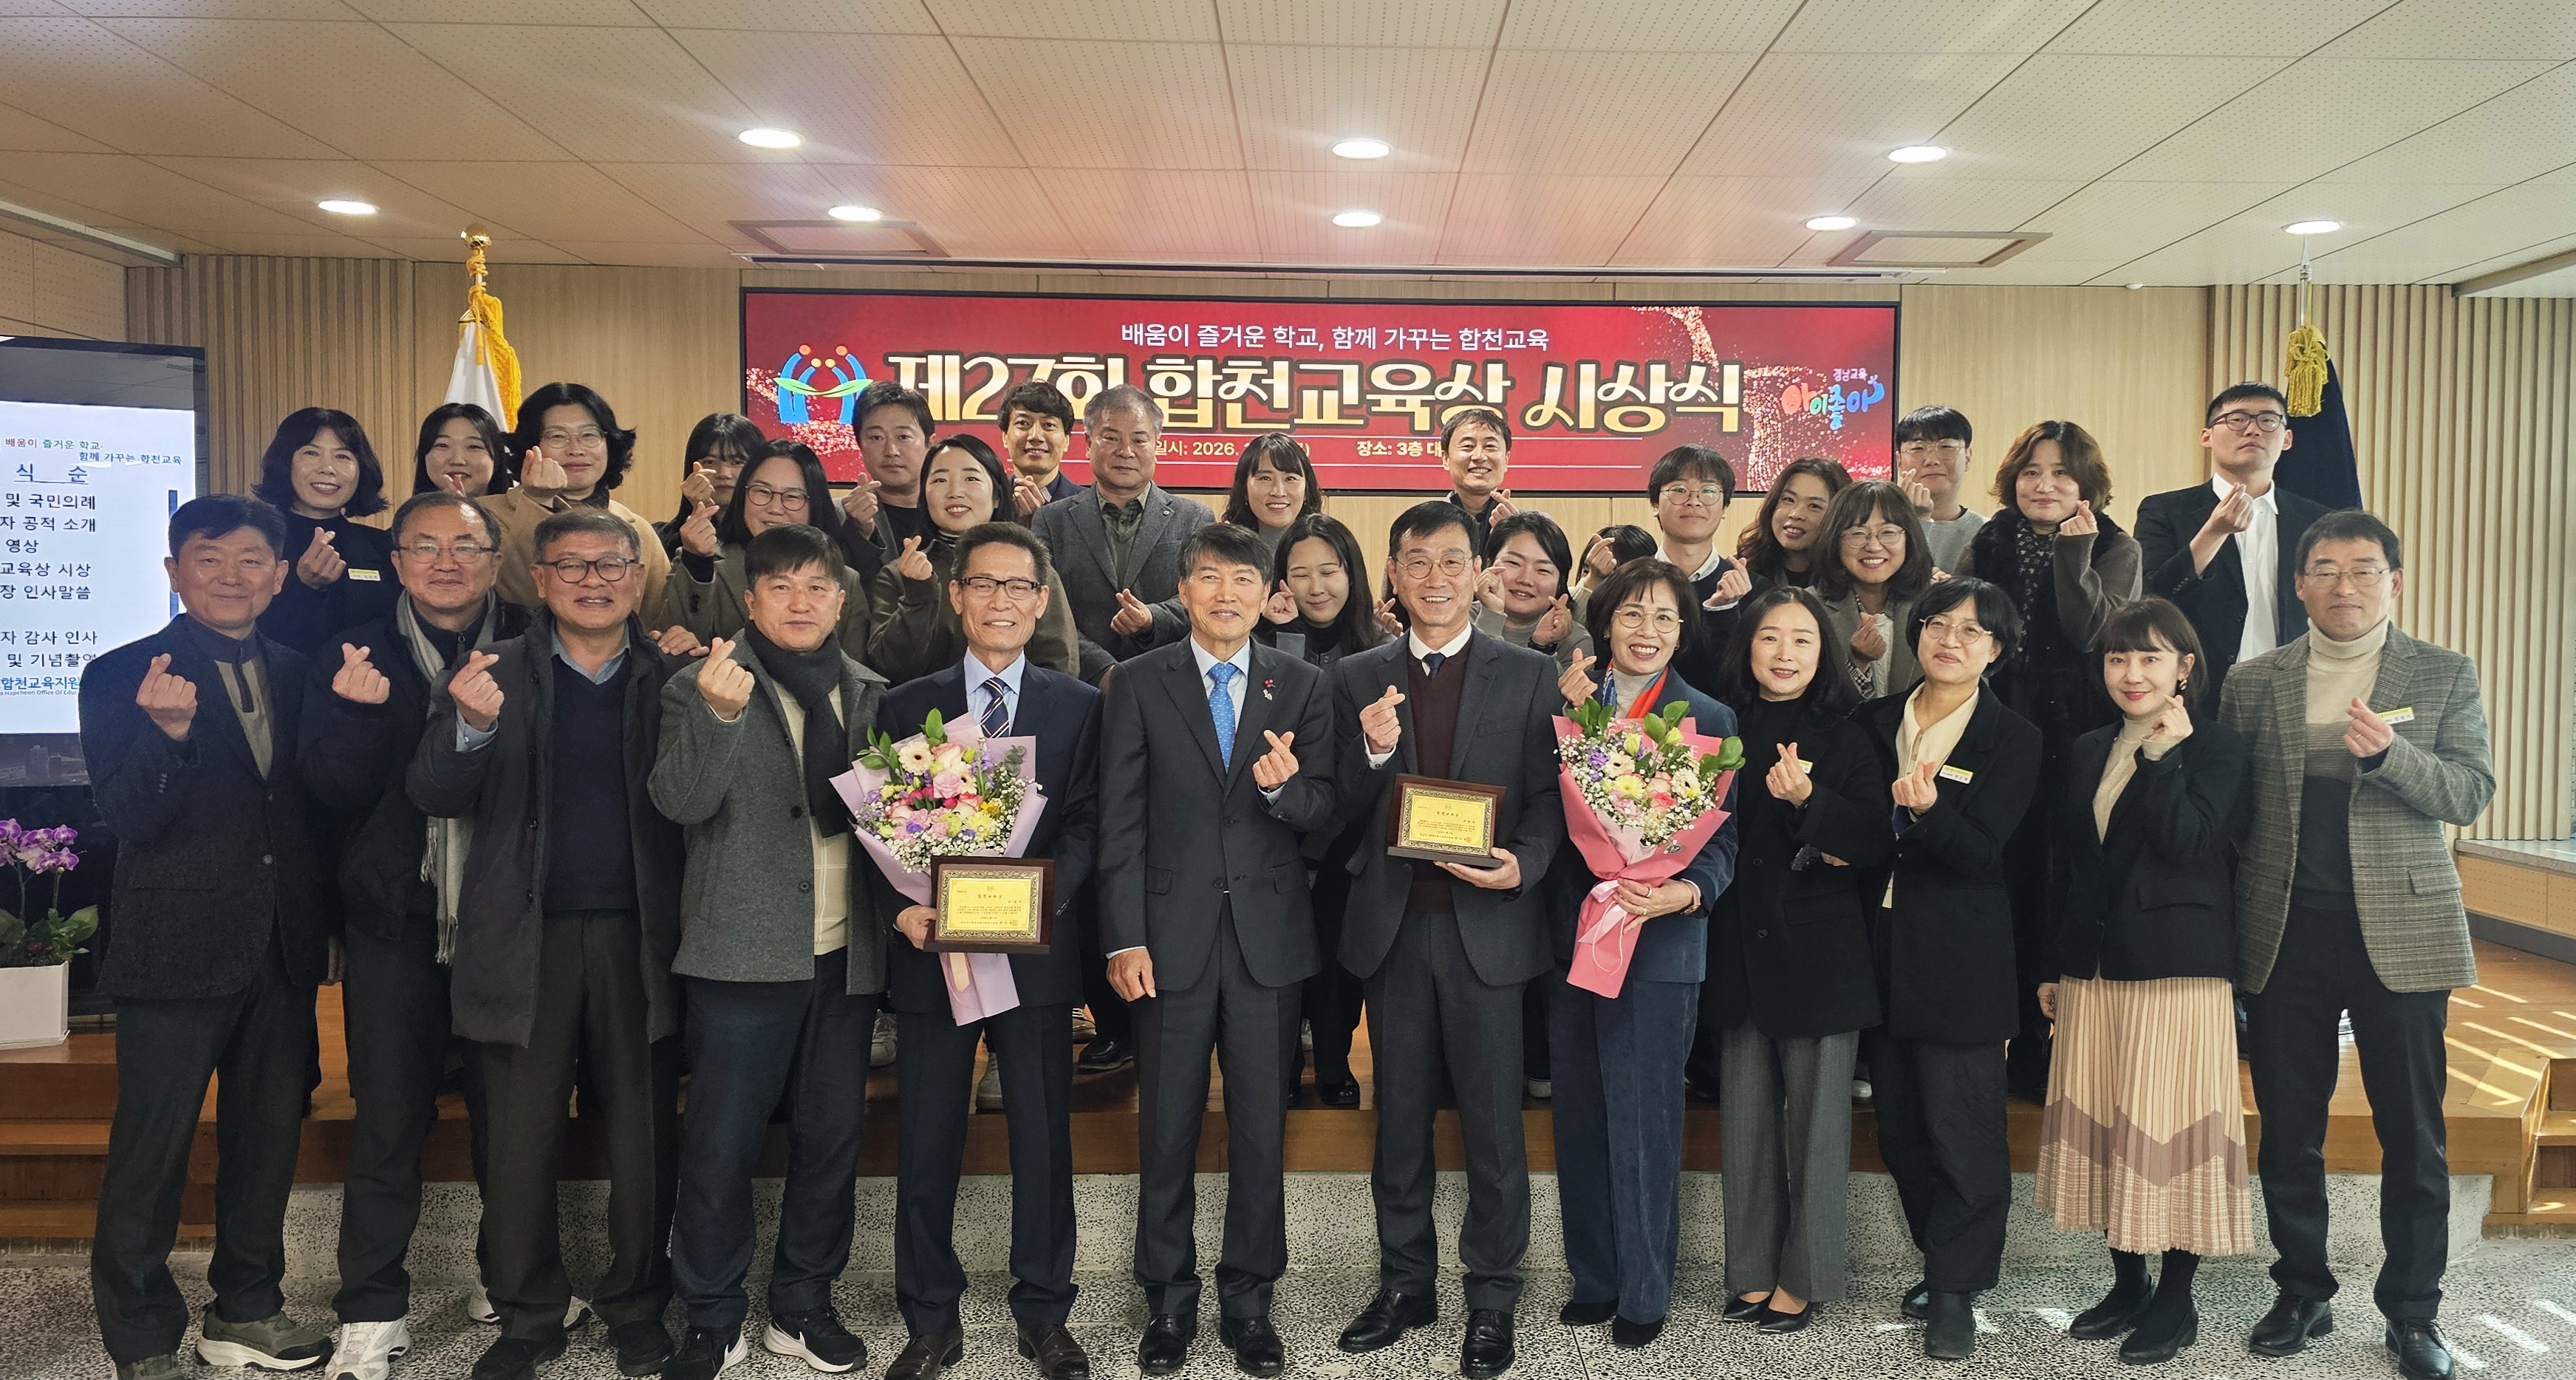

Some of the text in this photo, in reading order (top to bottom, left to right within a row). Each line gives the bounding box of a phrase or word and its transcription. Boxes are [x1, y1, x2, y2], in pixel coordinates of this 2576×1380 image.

[1121, 323, 1549, 352] 배움이 즐거운 학교, 함께 가꾸는 합천교육
[1833, 368, 1868, 381] 경남교육
[1147, 358, 1511, 431] 합천교육상
[1525, 363, 1740, 433] 시상식
[5, 438, 37, 448] 배움이
[42, 439, 75, 450] 즐거운
[1192, 442, 1240, 457] 2026.
[1356, 441, 1393, 457] 장소:
[1396, 442, 1424, 457] 3층
[79, 451, 100, 462] 함께
[104, 453, 136, 462] 가꾸는
[6, 493, 95, 510] 및 국민의례
[22, 516, 55, 532] 공적
[62, 518, 96, 533] 소개
[6, 539, 40, 554] 영상
[58, 563, 92, 578] 시상
[24, 584, 92, 600] 인사말씀
[24, 630, 58, 646] 감사
[65, 630, 98, 645] 인사
[7, 653, 23, 668] 및
